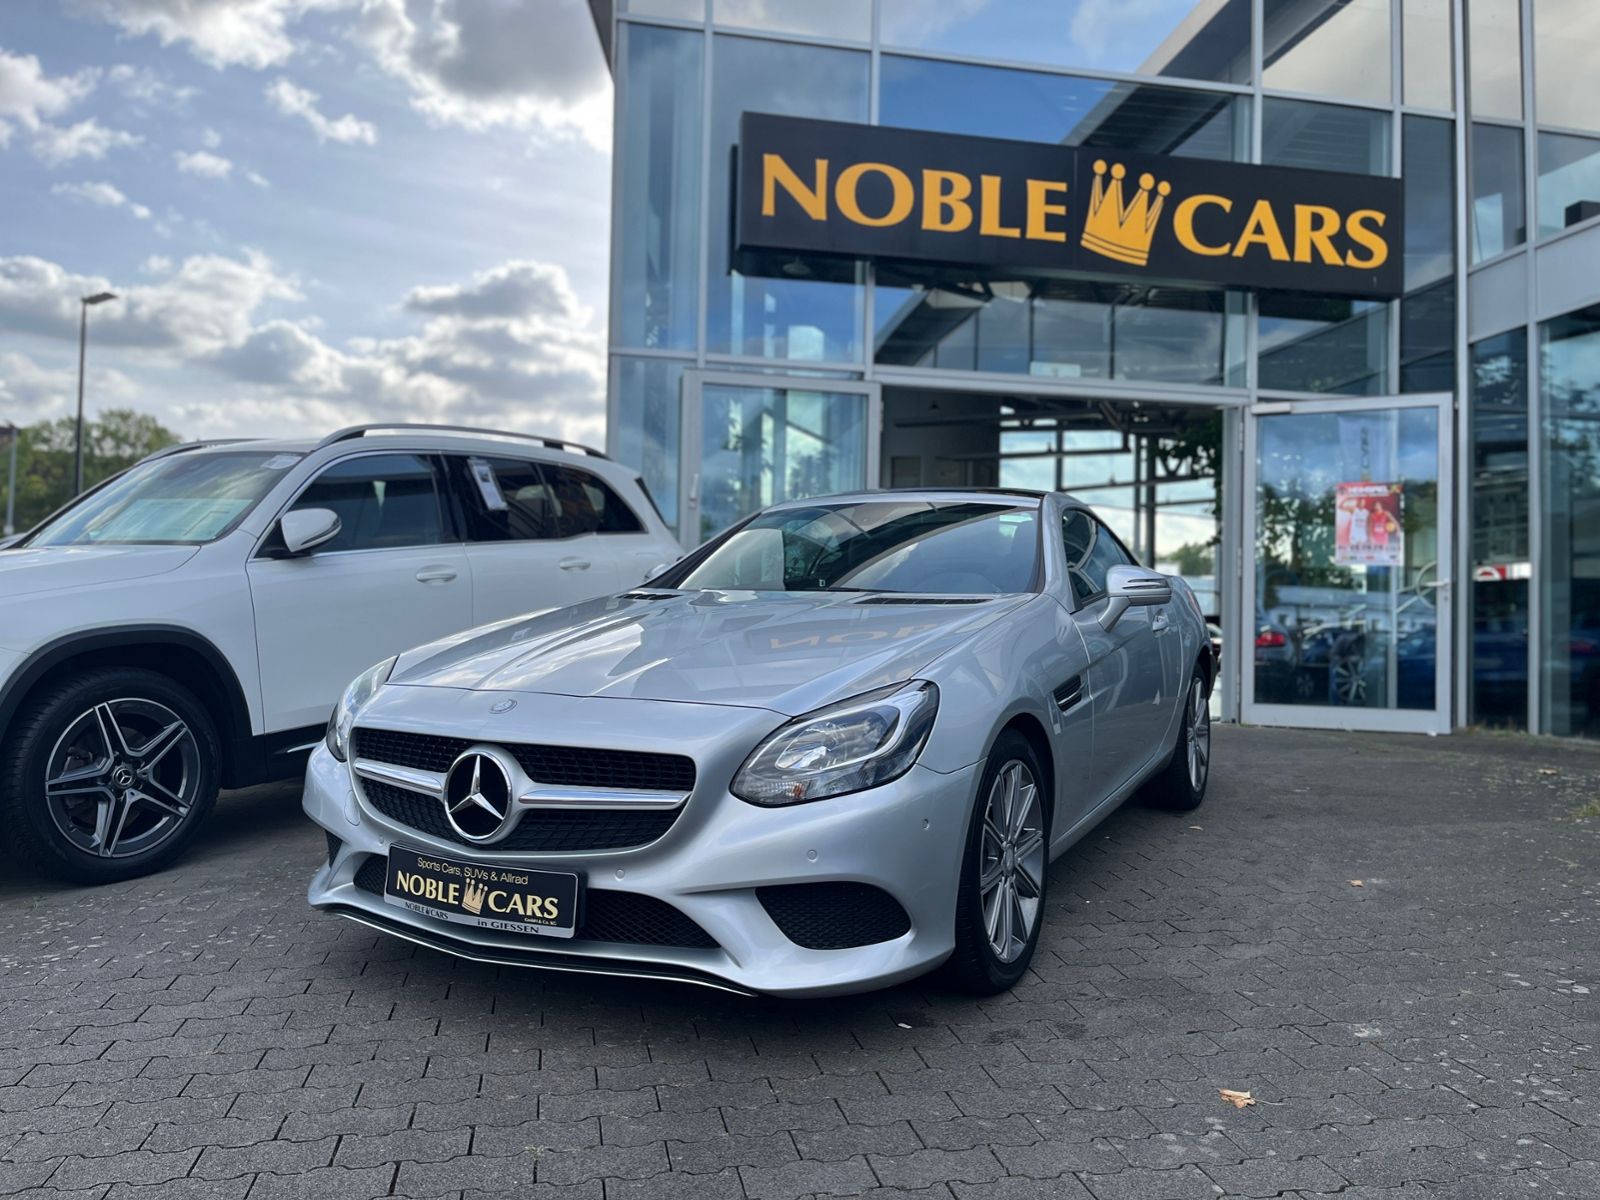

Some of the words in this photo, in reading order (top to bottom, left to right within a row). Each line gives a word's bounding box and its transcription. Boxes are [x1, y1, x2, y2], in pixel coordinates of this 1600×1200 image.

[762, 153, 1068, 242] NOBLE
[1173, 193, 1389, 269] CARS
[417, 857, 441, 872] Sports
[442, 863, 463, 877] Cars,
[464, 867, 489, 880] SUVs
[490, 871, 498, 881] &
[500, 872, 529, 885] Allrad
[396, 870, 460, 905] NOBLE
[488, 890, 559, 919] CARS
[430, 909, 449, 920] CARS
[491, 921, 540, 933] GIESSEN
